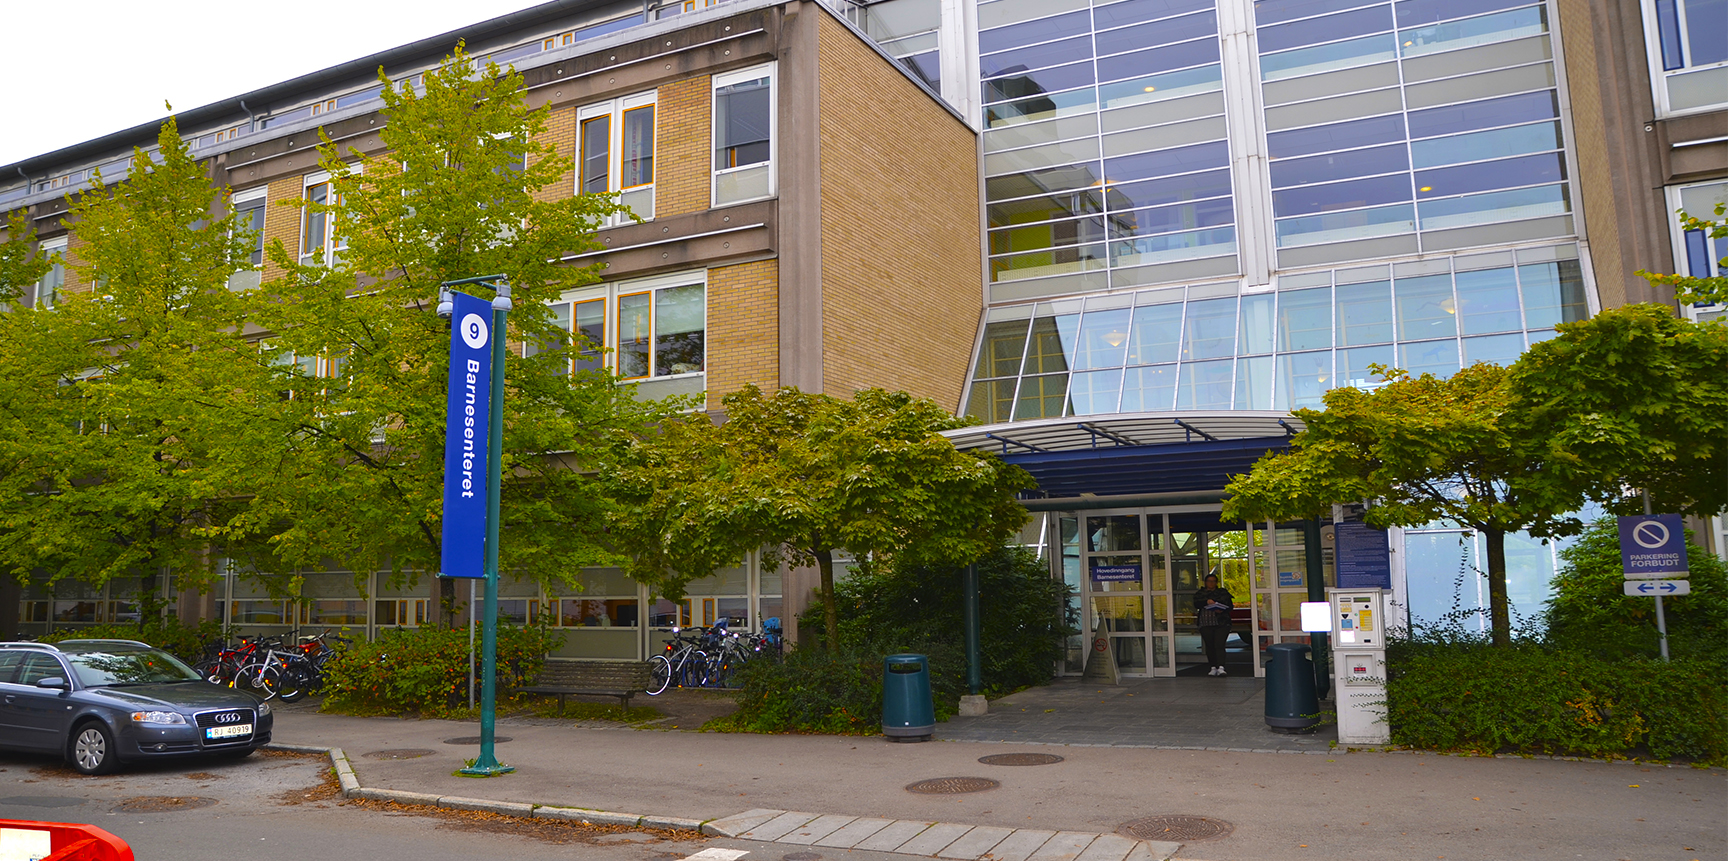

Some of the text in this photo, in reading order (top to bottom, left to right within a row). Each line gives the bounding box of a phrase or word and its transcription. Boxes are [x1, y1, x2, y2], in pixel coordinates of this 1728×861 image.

[469, 321, 480, 341] 9
[460, 358, 480, 499] Barnesenteret
[1631, 559, 1680, 567] FORBUDT
[214, 728, 223, 736] RJ
[227, 725, 249, 734] 40919
